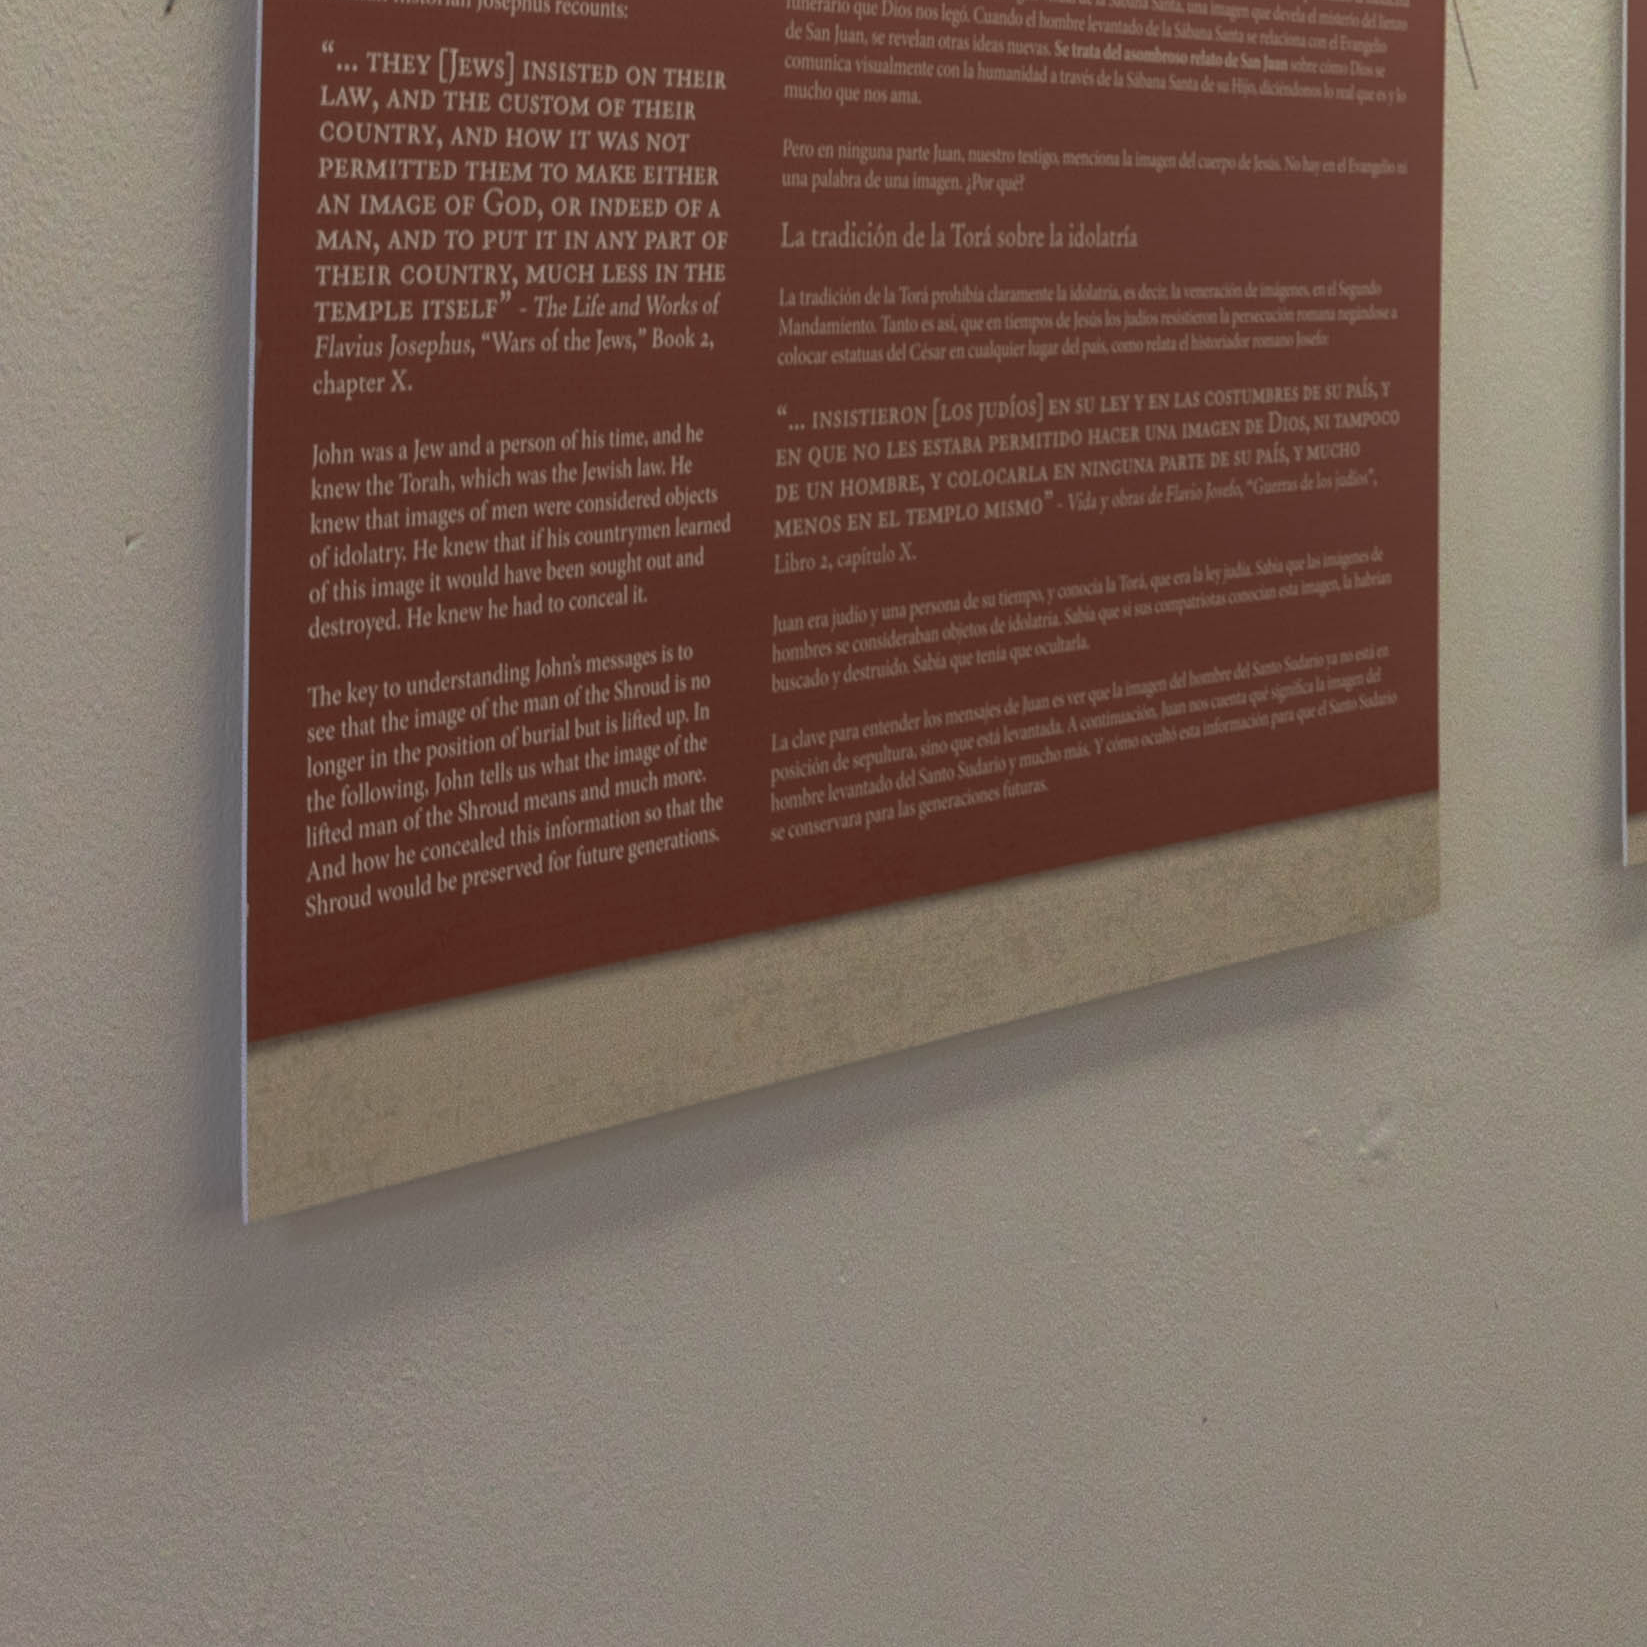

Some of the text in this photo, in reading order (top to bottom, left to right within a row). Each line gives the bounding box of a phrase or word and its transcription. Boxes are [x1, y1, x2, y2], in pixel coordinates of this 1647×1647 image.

[365, 51, 431, 75] THEY
[521, 59, 618, 84] INSISTED
[624, 65, 657, 86] ON
[662, 66, 727, 90] THEIR
[319, 84, 696, 121] LAW, AND THE CUSTOM OF THEIR
[779, 219, 1138, 249] La tradición de la Torá sobre la idolatría
[304, 827, 720, 918] Shroud would be preserved for future generations.
